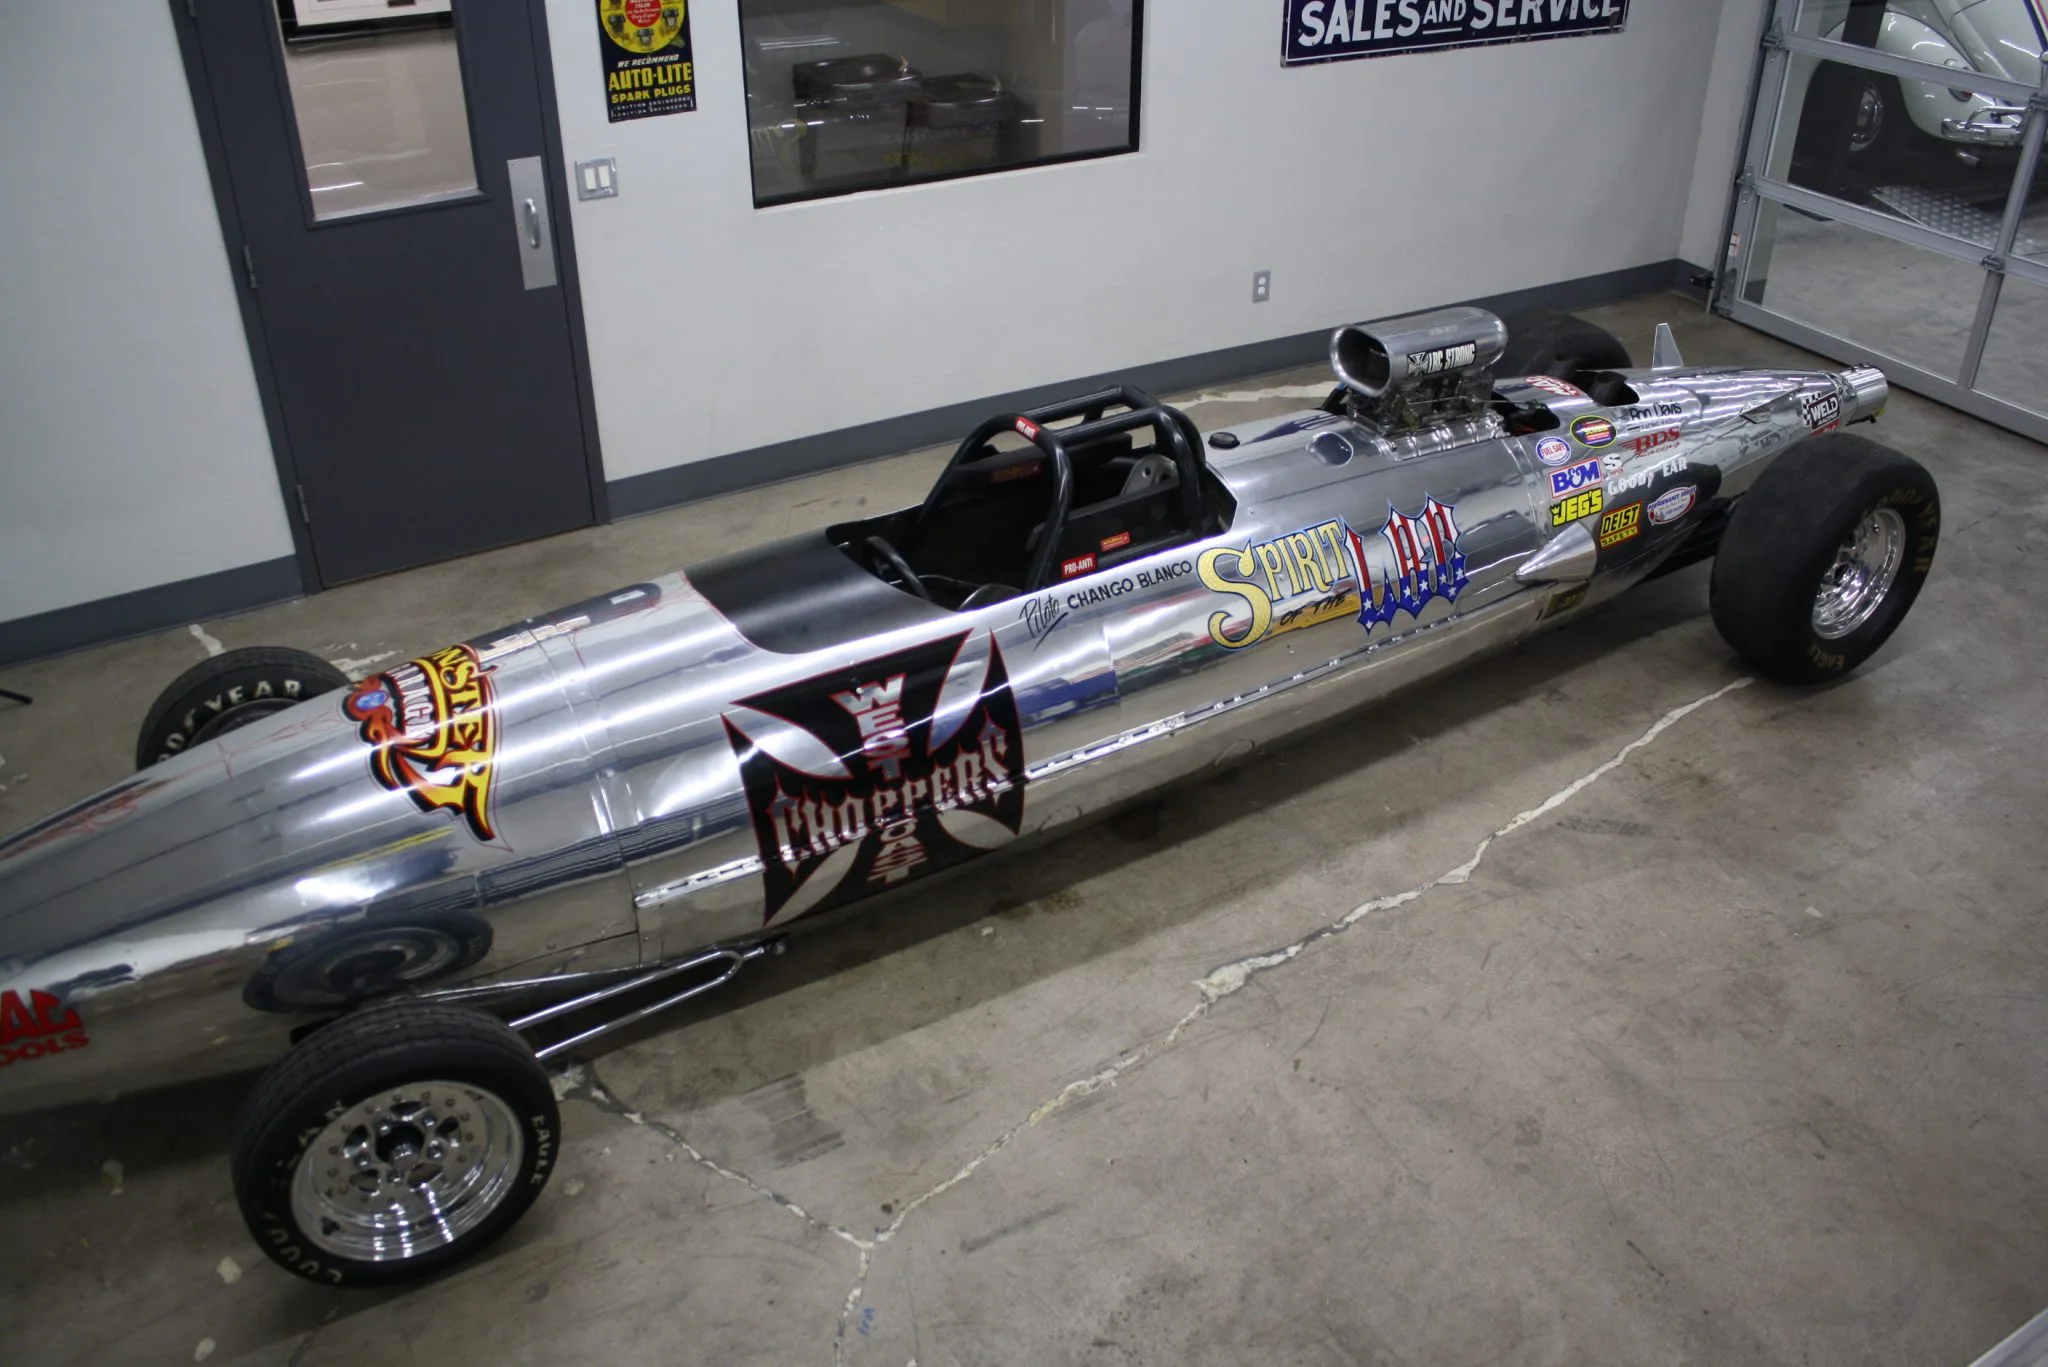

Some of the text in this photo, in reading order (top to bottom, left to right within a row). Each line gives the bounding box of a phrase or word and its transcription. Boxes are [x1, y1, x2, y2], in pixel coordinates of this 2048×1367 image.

[1298, 0, 1421, 47] SALES
[1423, 0, 1467, 25] AND
[609, 62, 692, 91] AUTO-LITE
[617, 53, 680, 69] WE RECOMMEND
[611, 84, 691, 104] SPARK PLUGS
[1444, 343, 1476, 370] STRONG
[1629, 407, 1652, 420] Ron
[1810, 396, 1839, 422] WELD
[1636, 427, 1680, 452] BDS
[1551, 460, 1600, 494] B&M
[1553, 489, 1603, 526] JEG'S
[1602, 506, 1640, 534] DEIST
[1601, 526, 1638, 547] SAFETY
[1063, 557, 1093, 576] PRO-ANTI
[1067, 577, 1134, 610] CHANGO
[1136, 560, 1193, 589] BLANCO
[1196, 520, 1352, 650] SPIRIT
[1279, 594, 1347, 626] OF THE
[829, 672, 911, 784] WEST
[766, 705, 1013, 885] CHOPPERS
[866, 816, 929, 885] COAST
[0, 989, 84, 1046] AC
[0, 1032, 90, 1070] OOLS
